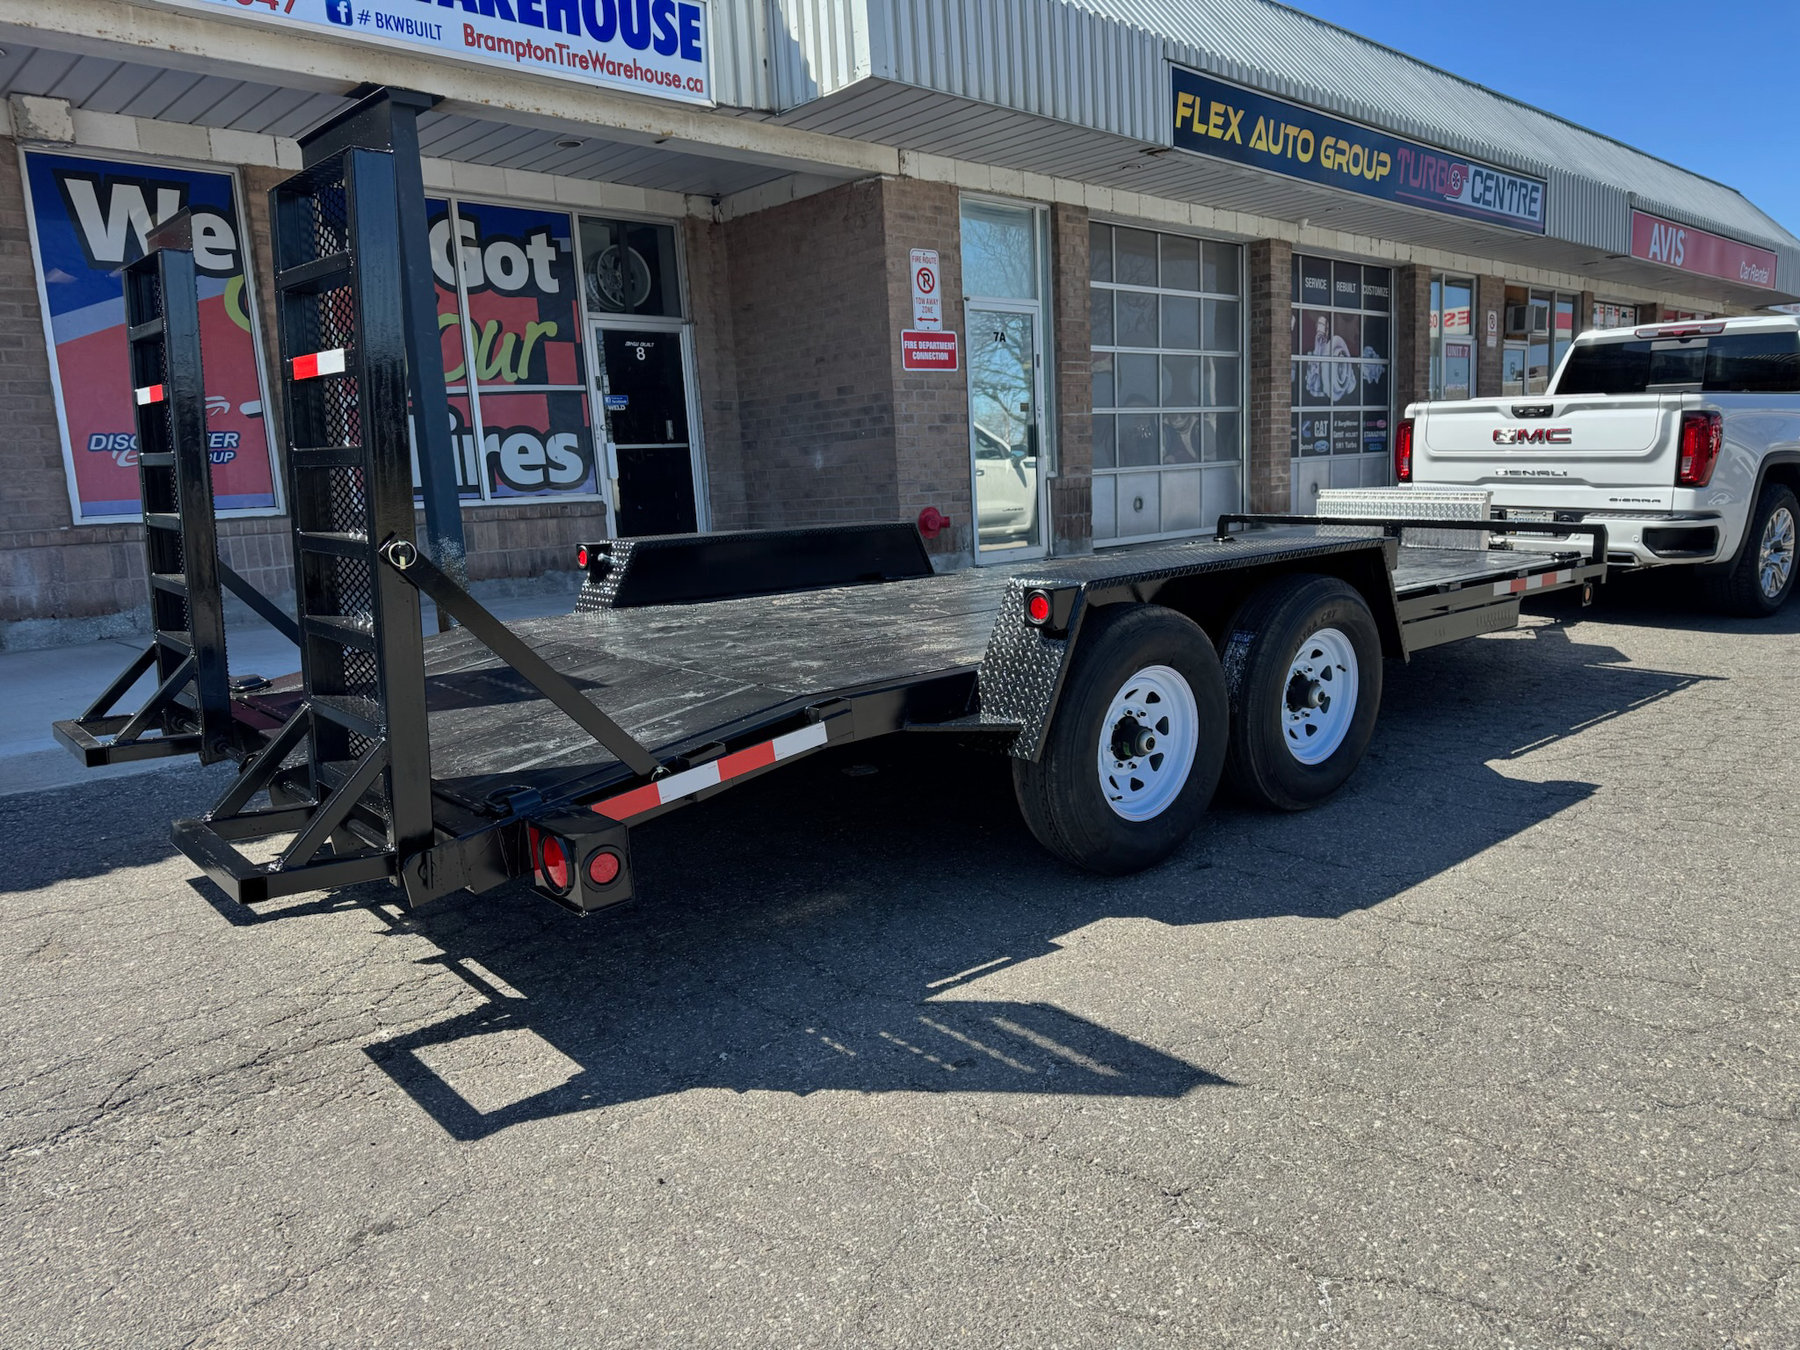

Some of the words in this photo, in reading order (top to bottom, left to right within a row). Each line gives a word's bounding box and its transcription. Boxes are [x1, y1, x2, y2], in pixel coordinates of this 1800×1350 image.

[357, 9, 371, 25] #
[375, 12, 442, 41] BKWBUILT
[403, 0, 703, 63] HOUSE
[463, 23, 704, 93] BramptonTireWarehouse.ca
[1175, 91, 1245, 145] FLEX
[1249, 115, 1315, 163] AUTO
[1320, 135, 1391, 182] GROUP
[1472, 169, 1540, 218] CENTRE
[64, 178, 237, 271] We
[428, 217, 560, 293] Got
[1648, 223, 1686, 266] AVIS
[1740, 261, 1751, 279] Car
[1751, 263, 1769, 284] Rental
[1305, 277, 1327, 290] SERVICE
[1336, 281, 1356, 293] REBUILT
[1362, 284, 1389, 297] CUSTOMIZE
[904, 341, 917, 349] FIRE
[918, 341, 955, 350] DEPARTMENT
[993, 332, 1006, 342] 7A
[437, 313, 558, 383] our
[636, 347, 646, 360] 8
[912, 351, 949, 361] CONNECTION
[1447, 345, 1463, 357] UNIT
[1463, 346, 1469, 357] 7
[1314, 420, 1328, 437] CAT
[1493, 427, 1572, 445] GMC
[90, 432, 239, 450] DISCER
[408, 412, 583, 487] res
[1496, 469, 1568, 477] DENALI
